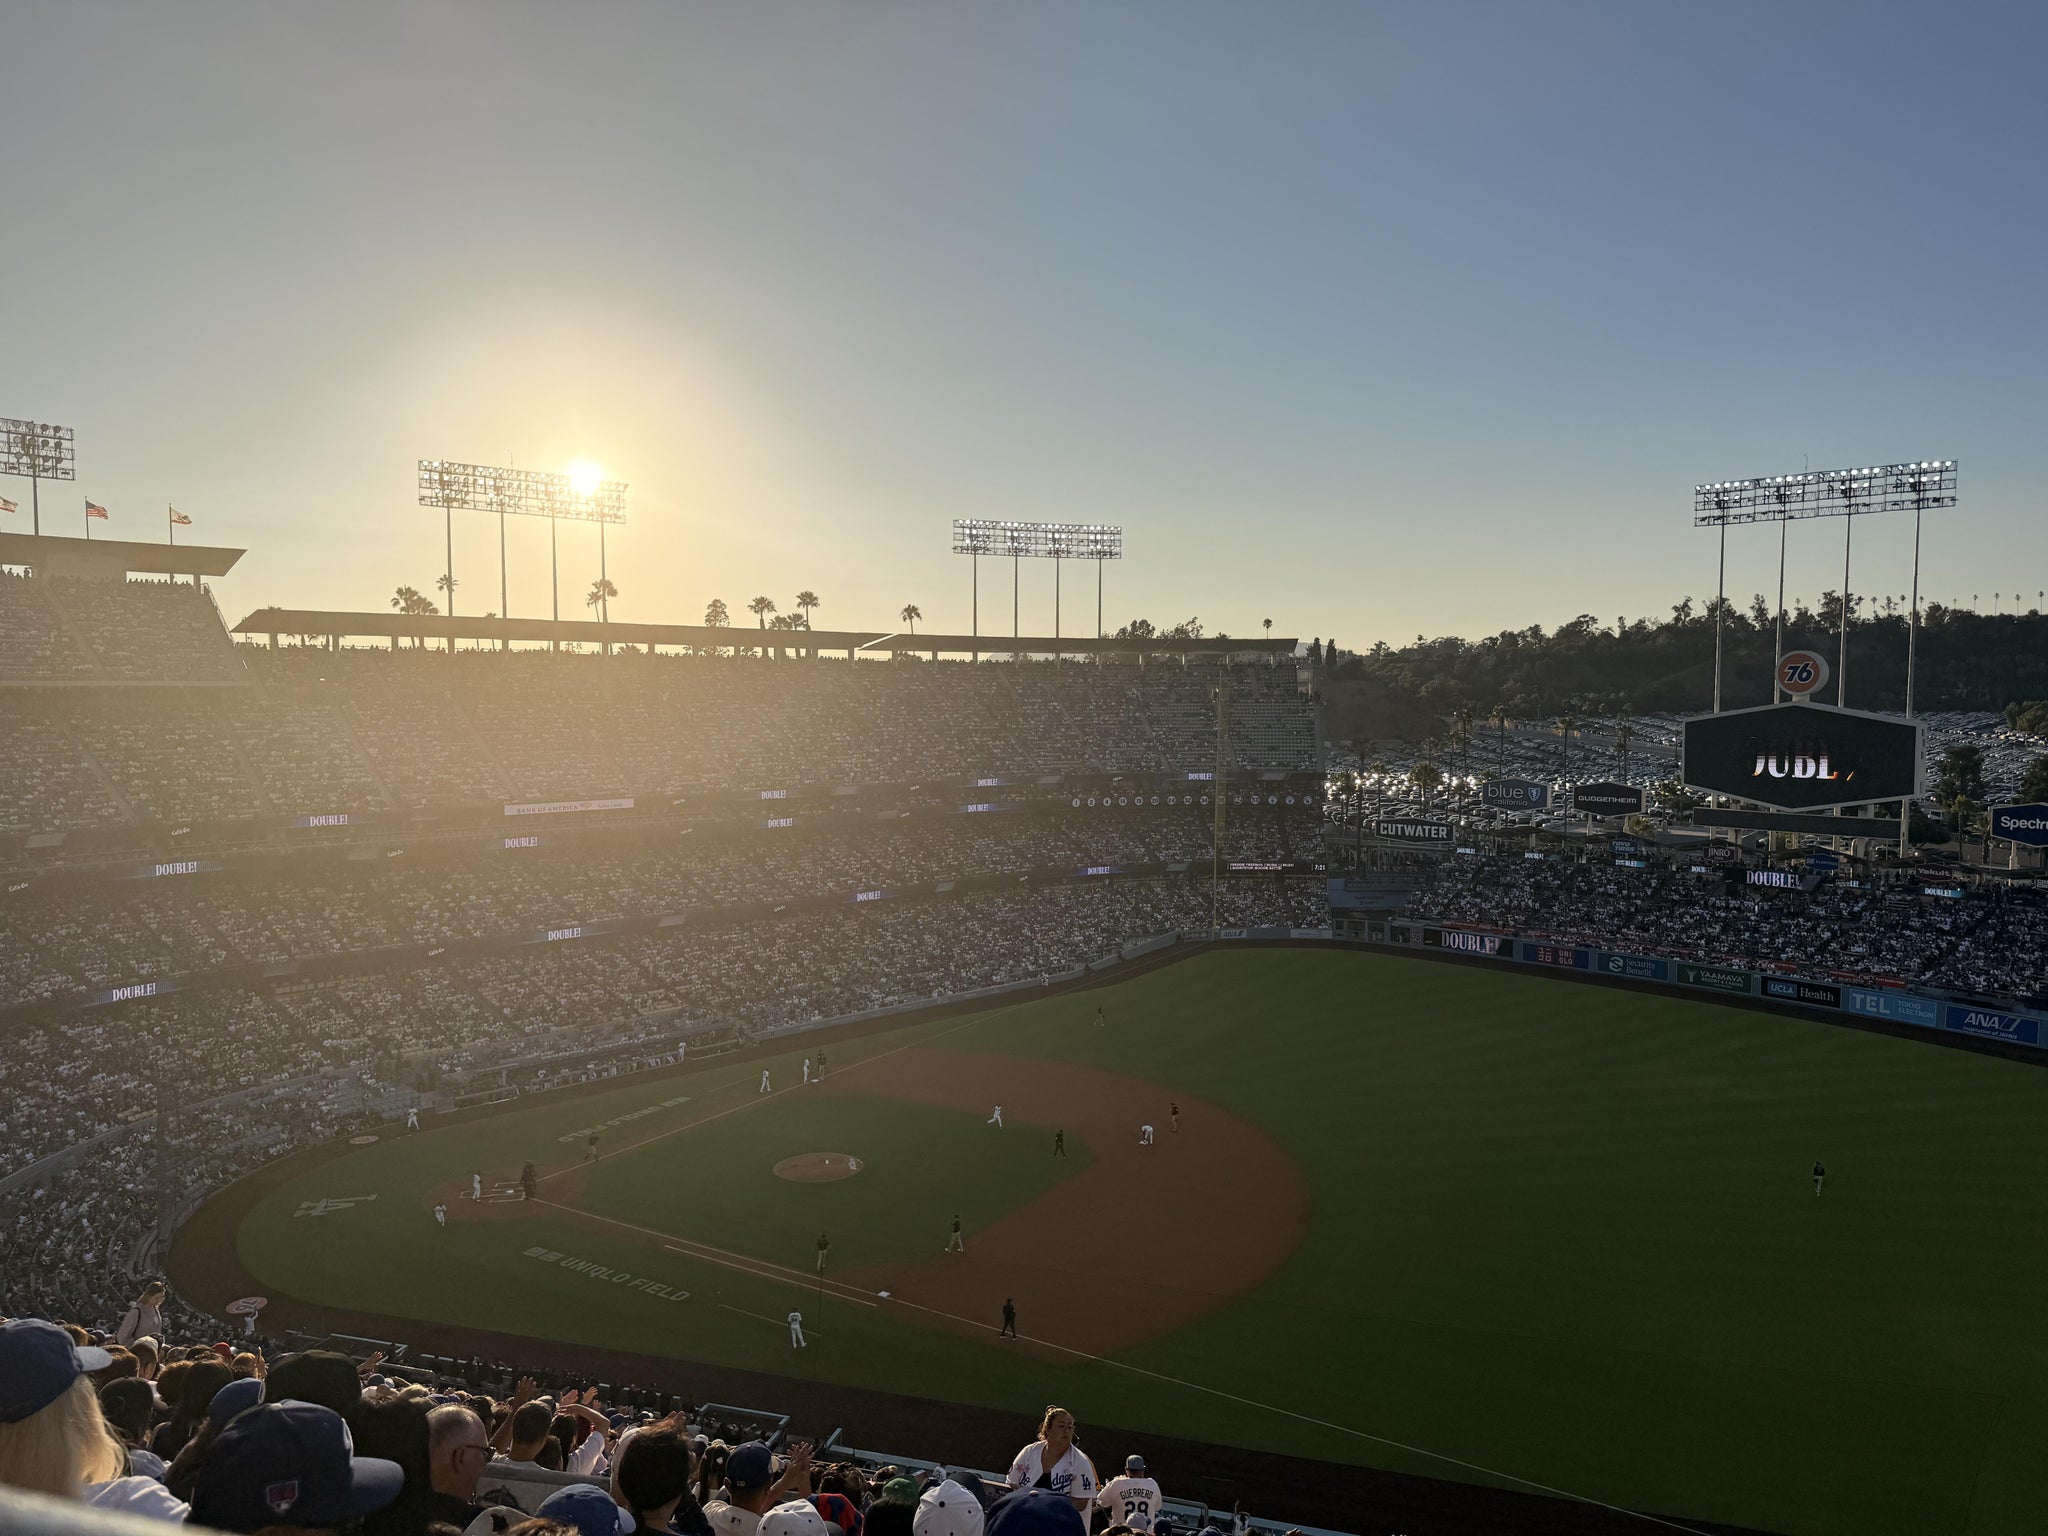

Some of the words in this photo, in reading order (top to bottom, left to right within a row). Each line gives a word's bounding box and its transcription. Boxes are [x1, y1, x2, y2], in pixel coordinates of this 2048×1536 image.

[1784, 661, 1814, 684] 76
[1488, 784, 1524, 799] blue
[1578, 795, 1637, 804] GUGGENHEIM
[310, 814, 348, 827] DOUBLE!
[2000, 816, 2048, 830] Spectr
[1380, 822, 1448, 839] CUTWATER
[504, 836, 538, 849] DOUBLE!
[1708, 848, 1731, 857] JINRO
[155, 861, 198, 877] DOUBLE!
[1918, 868, 1951, 877] Yakult
[547, 927, 582, 941] DOUBLE!
[1626, 958, 1656, 972] Security
[1626, 967, 1651, 977] Benefit
[112, 982, 157, 1001] DOUBLE!
[1770, 983, 1794, 995] UCLA
[1800, 988, 1835, 1001] Health
[1852, 993, 1890, 1014] TEL
[1898, 1001, 1921, 1010] TOKYO
[1898, 1008, 1934, 1018] ELECTRON
[1964, 1012, 2000, 1030] ANA
[560, 1257, 631, 1283] UNIQLO
[627, 1278, 690, 1301] FIELD
[1081, 1474, 1091, 1490] LA
[1120, 1488, 1154, 1500] GUERRERO
